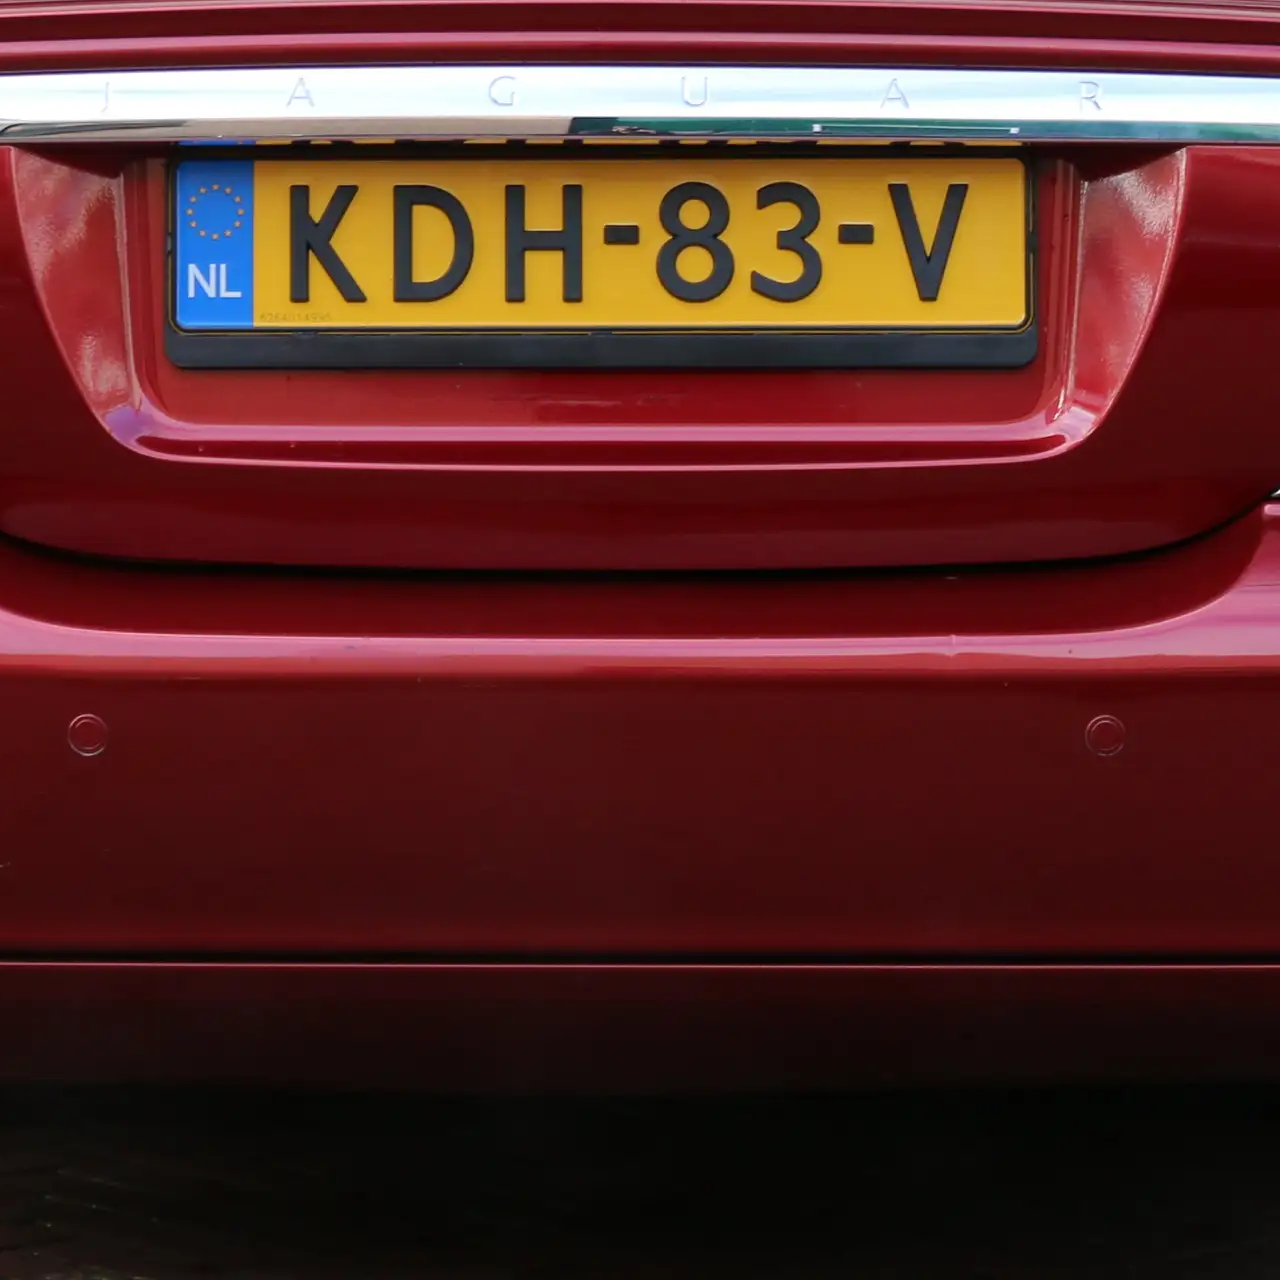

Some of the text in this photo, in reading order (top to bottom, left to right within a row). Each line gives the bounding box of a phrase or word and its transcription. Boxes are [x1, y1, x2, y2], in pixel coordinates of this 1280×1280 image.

[100, 74, 1103, 114] JAGUAR
[289, 181, 969, 303] KDH-83-V
[187, 263, 242, 298] NL
